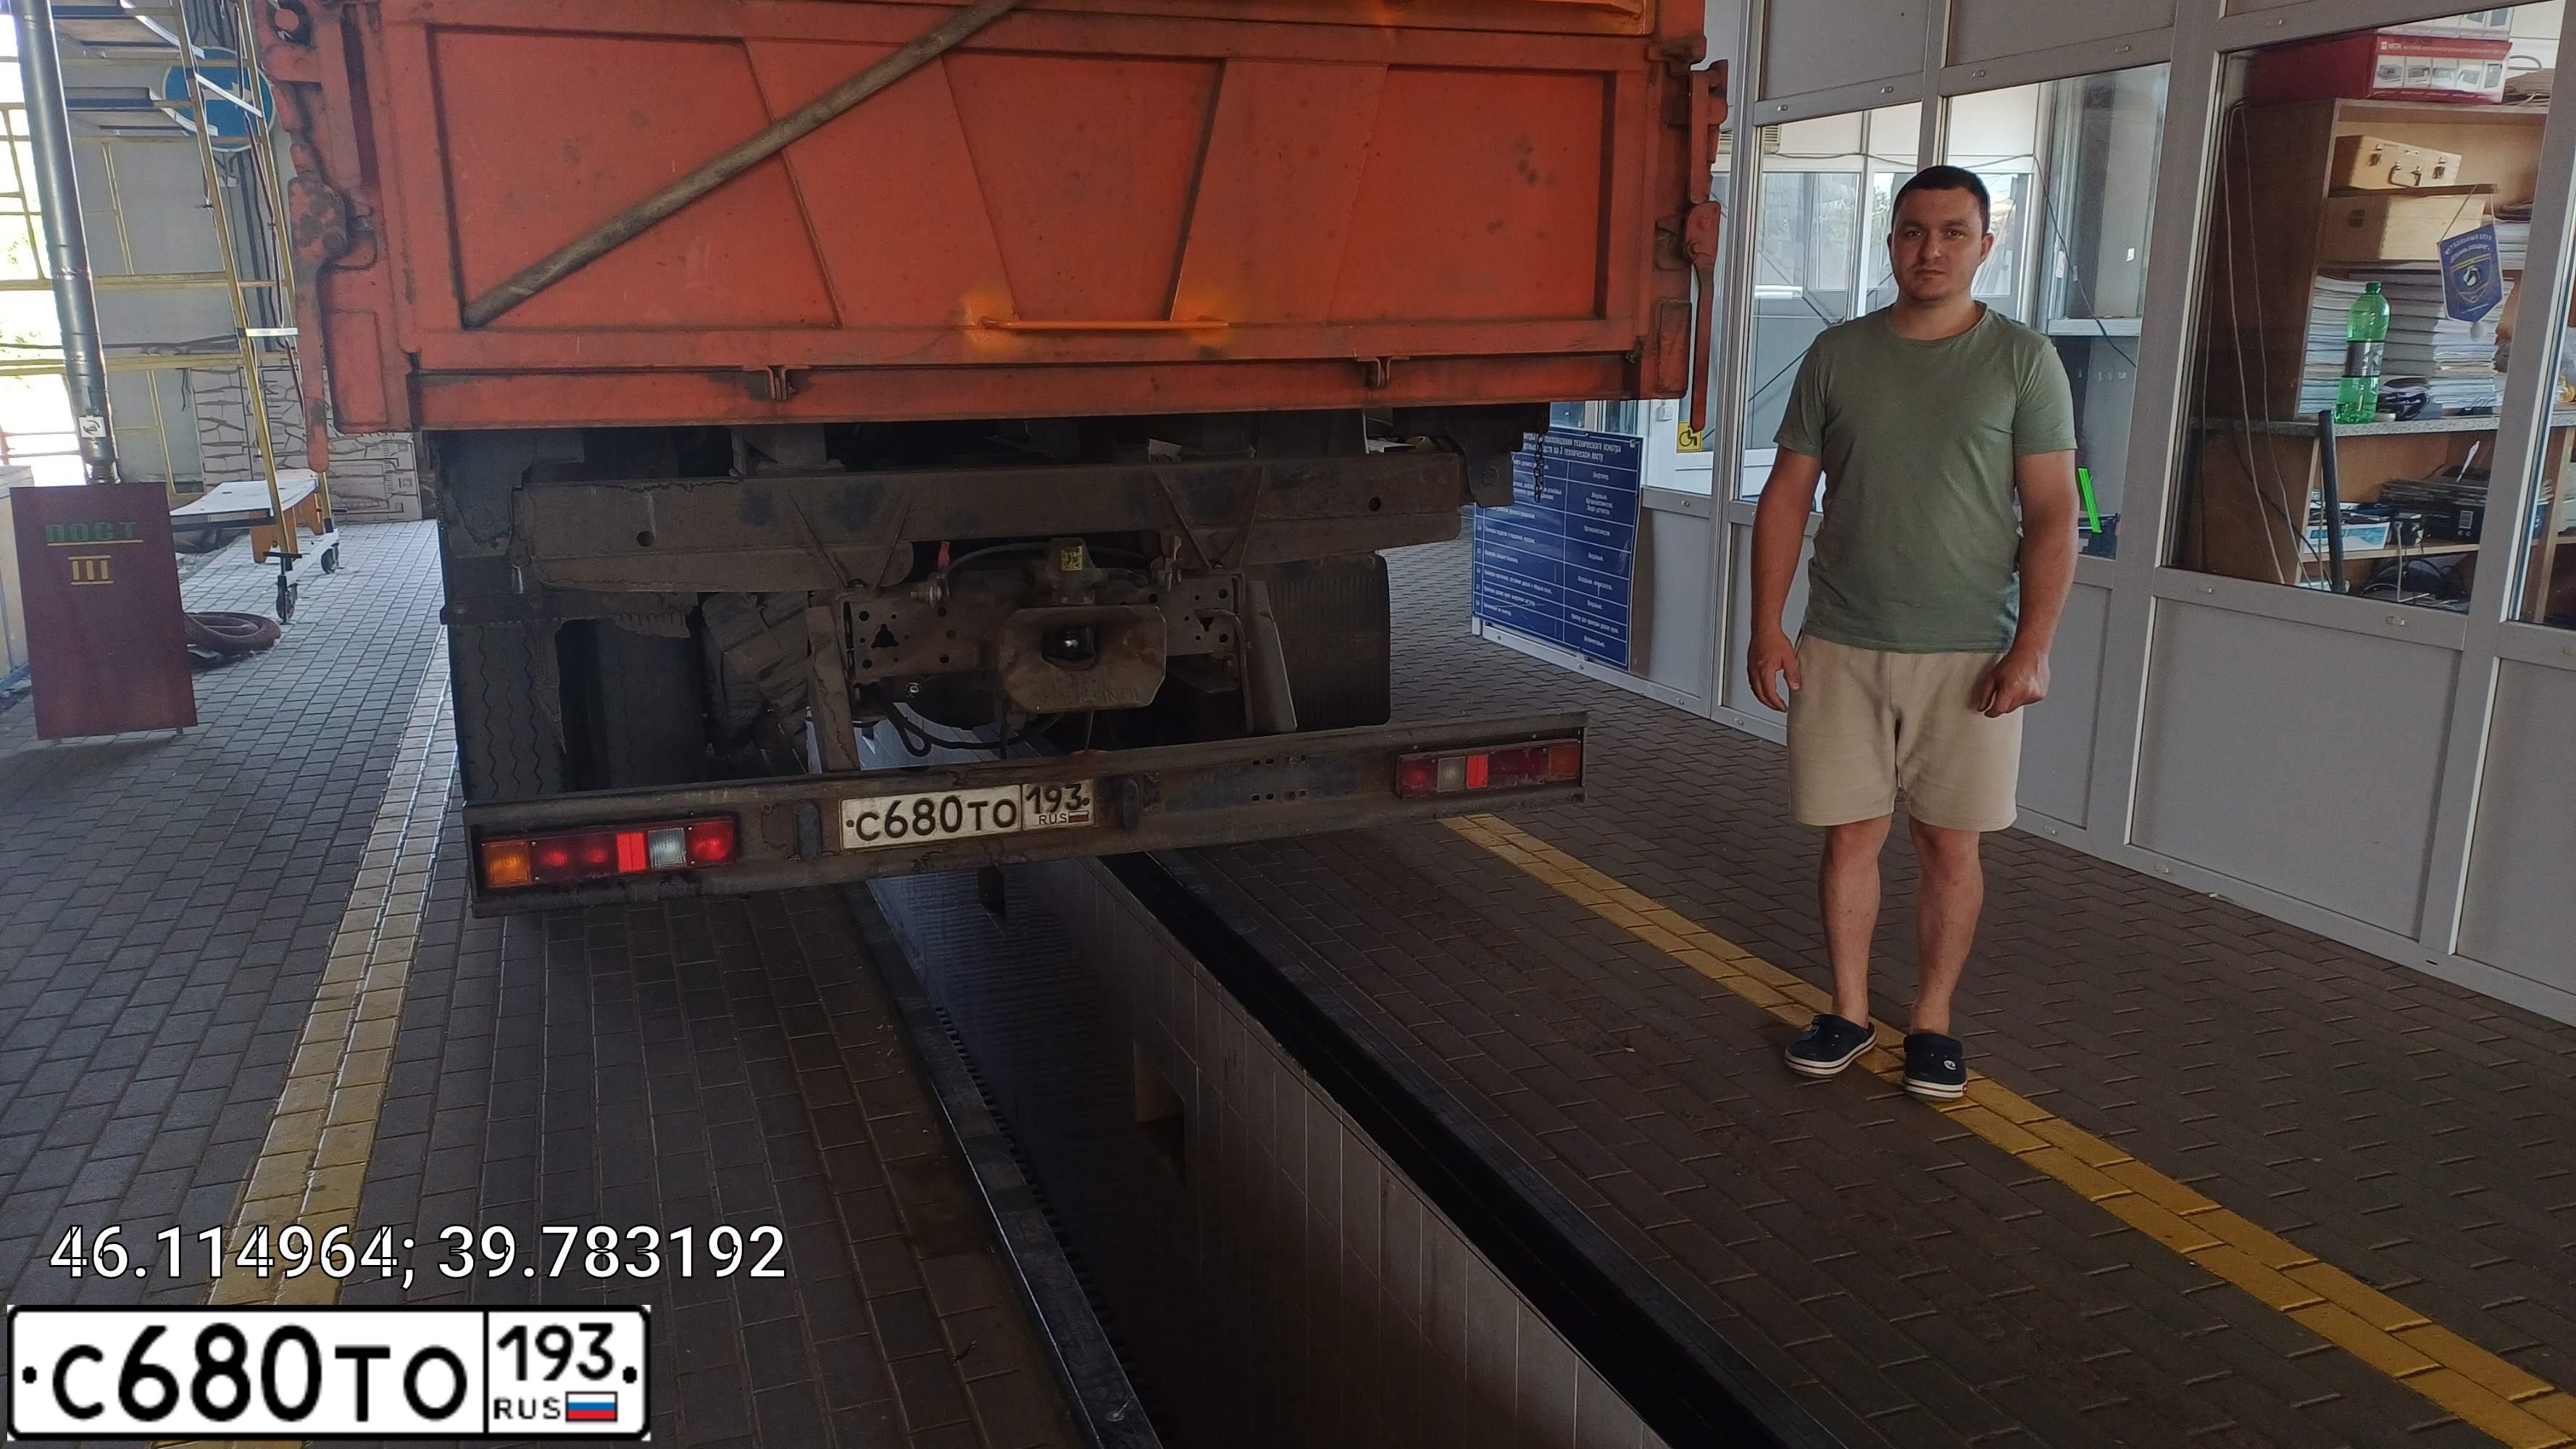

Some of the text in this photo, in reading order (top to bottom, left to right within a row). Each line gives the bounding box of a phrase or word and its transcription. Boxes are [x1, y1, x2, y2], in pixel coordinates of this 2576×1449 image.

[46, 522, 137, 543] ПОСТ
[856, 782, 1083, 842] С680ТО 193
[1038, 812, 1067, 825] RUS
